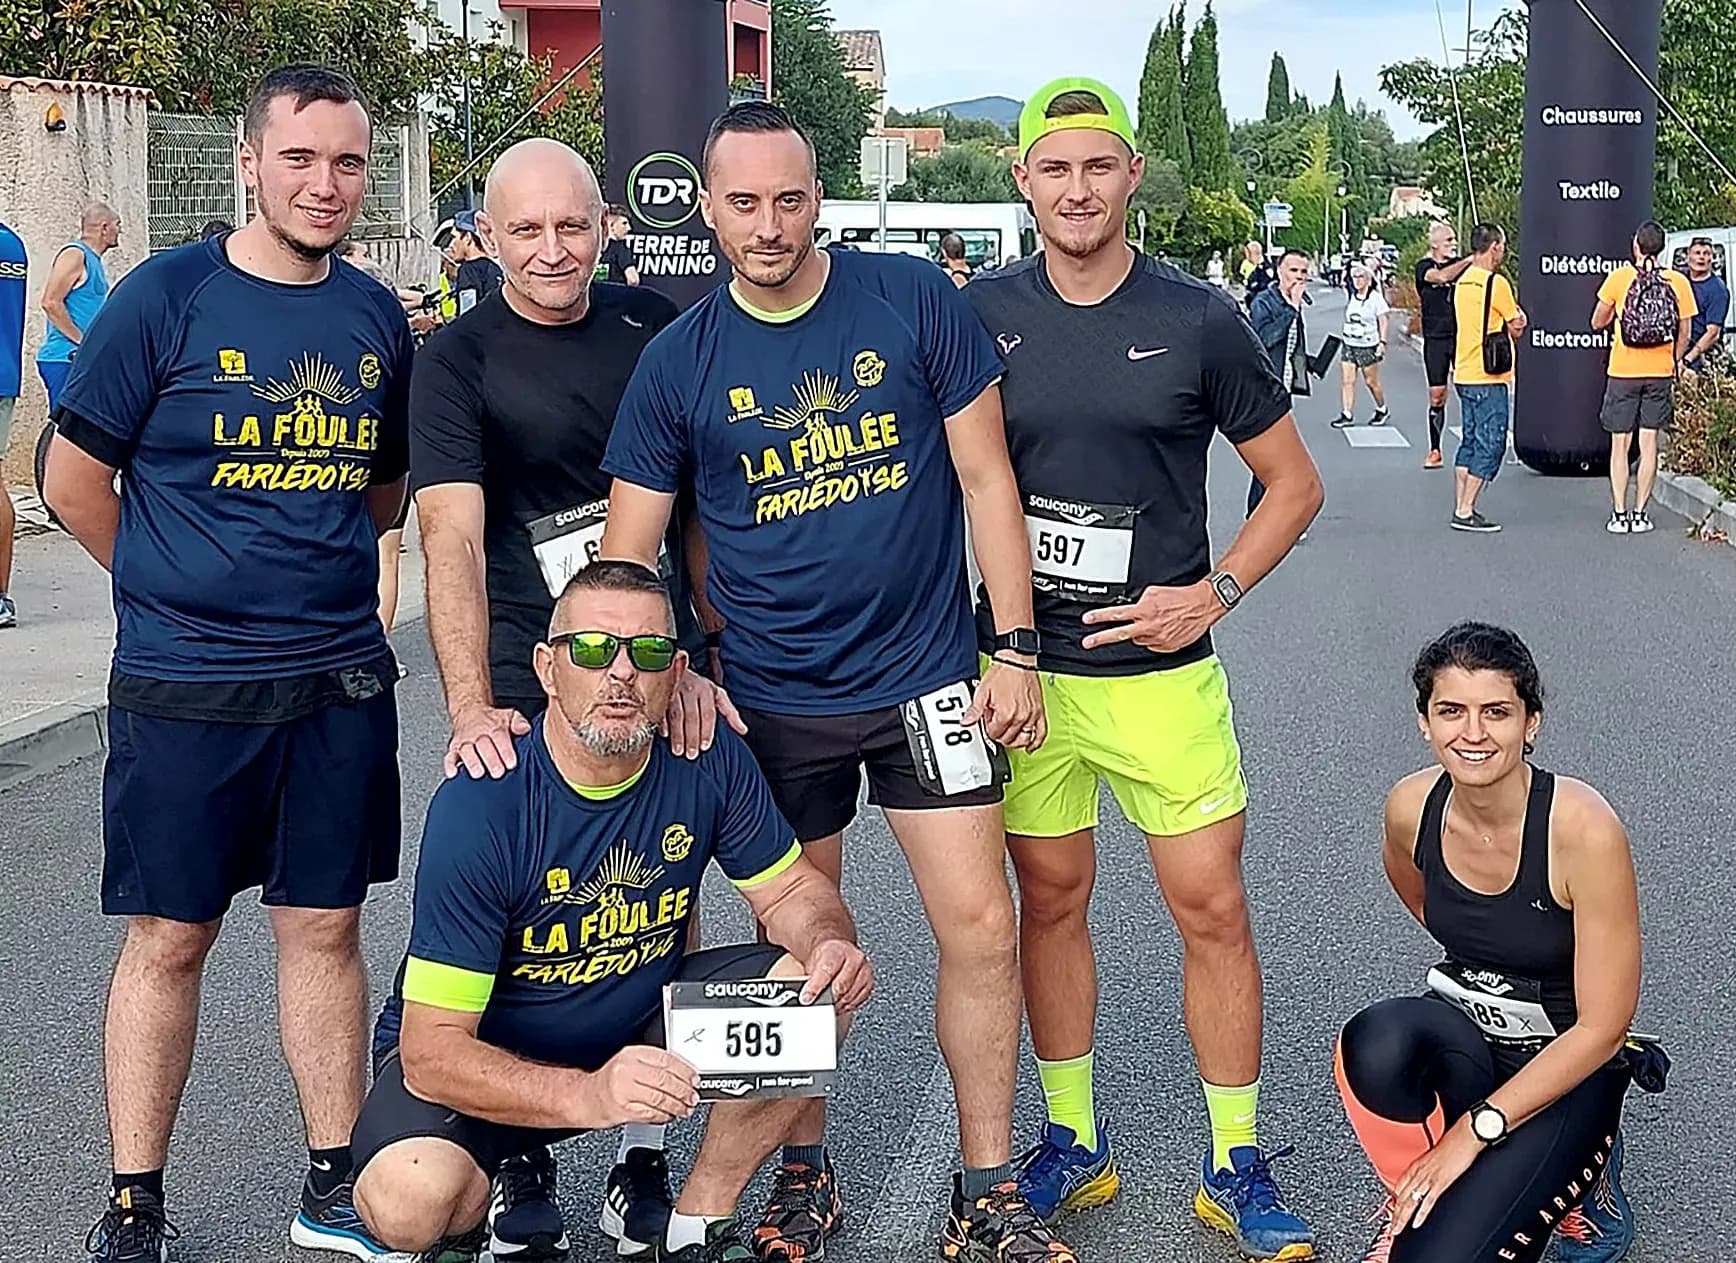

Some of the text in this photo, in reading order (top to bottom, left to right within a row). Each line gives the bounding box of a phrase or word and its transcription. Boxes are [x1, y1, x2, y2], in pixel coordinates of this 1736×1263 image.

[1542, 106, 1642, 125] Chaussures
[638, 178, 693, 204] TDR
[1559, 181, 1620, 198] Textile
[625, 235, 711, 255] TERRE DE
[633, 254, 717, 275] UNNING
[1532, 329, 1615, 348] Electroni
[214, 413, 378, 450] LA FOULÉE
[741, 412, 899, 483] LA FOULÉE
[555, 499, 610, 526] saucon
[1029, 495, 1087, 517] saucony
[1037, 531, 1085, 566] 597
[935, 696, 972, 746] 578
[522, 887, 690, 954] LA FOULÉE
[705, 983, 780, 998] saucony
[1459, 997, 1508, 1029] 585
[726, 1020, 783, 1057] 595
[1539, 1135, 1613, 1224] ARMOUR
